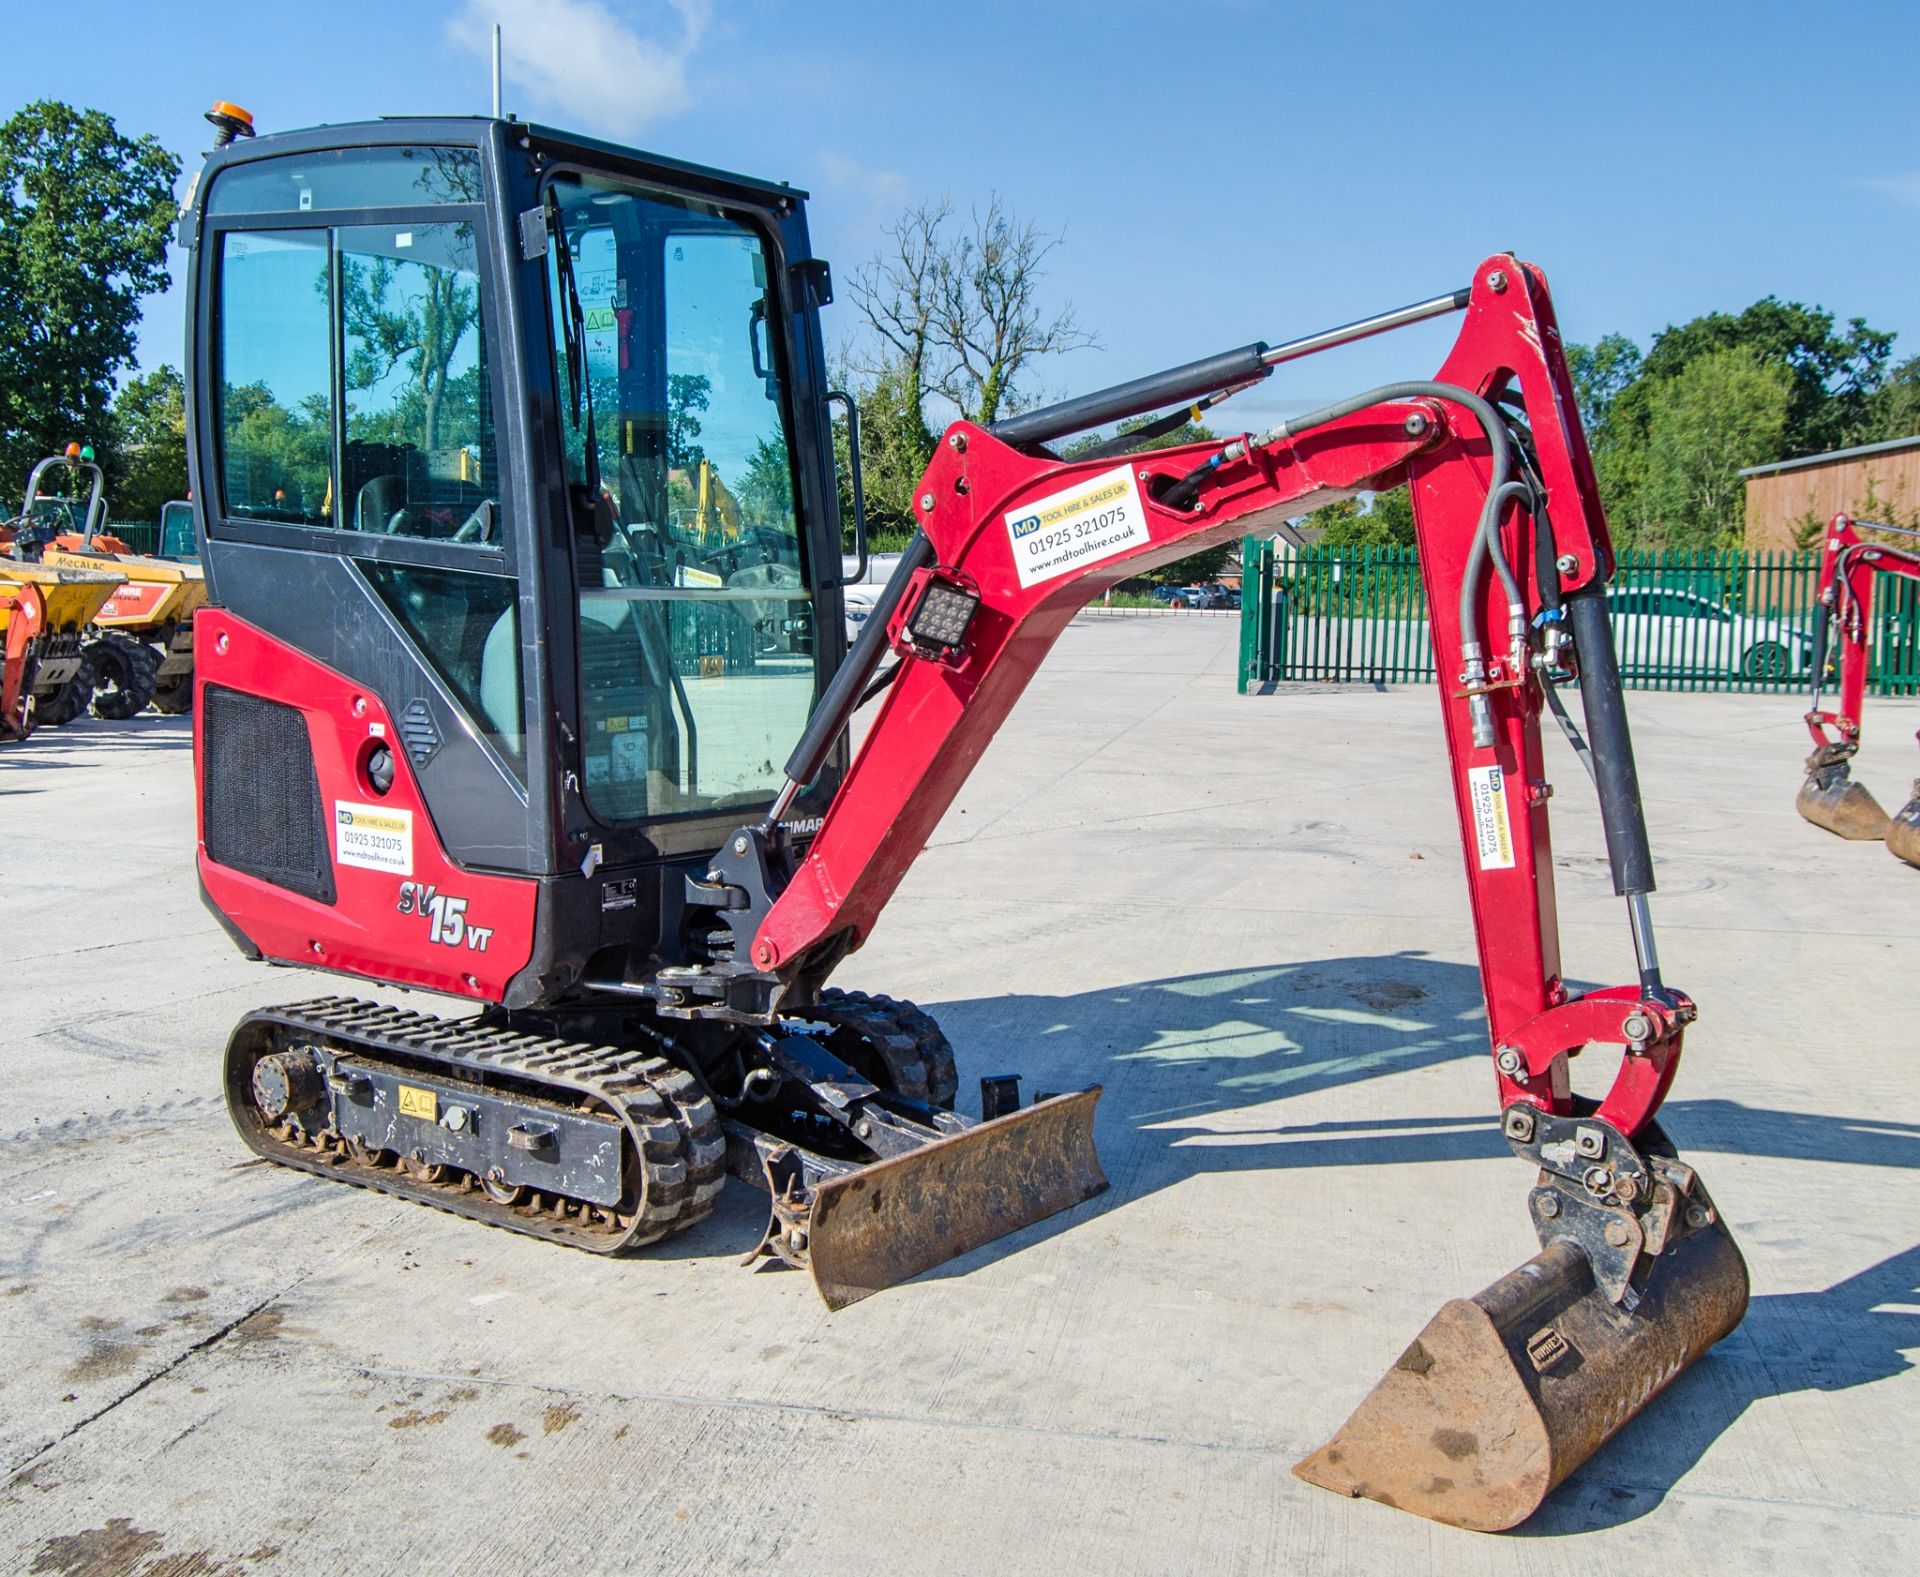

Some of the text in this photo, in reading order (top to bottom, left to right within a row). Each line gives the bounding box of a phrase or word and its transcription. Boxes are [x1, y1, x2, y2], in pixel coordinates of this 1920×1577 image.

[1014, 483, 1126, 537] MD TOOL HIRE & SALES UK
[1029, 507, 1126, 555] 01925 321075
[1029, 525, 1136, 573] www.mdtoolhire.co.uk
[1490, 772, 1500, 790] MD
[339, 811, 352, 824] MD
[777, 817, 825, 834] NMAR
[1473, 781, 1489, 857] www.mdtoolhire.co.uk
[1480, 783, 1498, 853] 01925 321075
[343, 849, 405, 865] www.mdtoolhire.co.uk
[345, 831, 402, 851] 01925 321075
